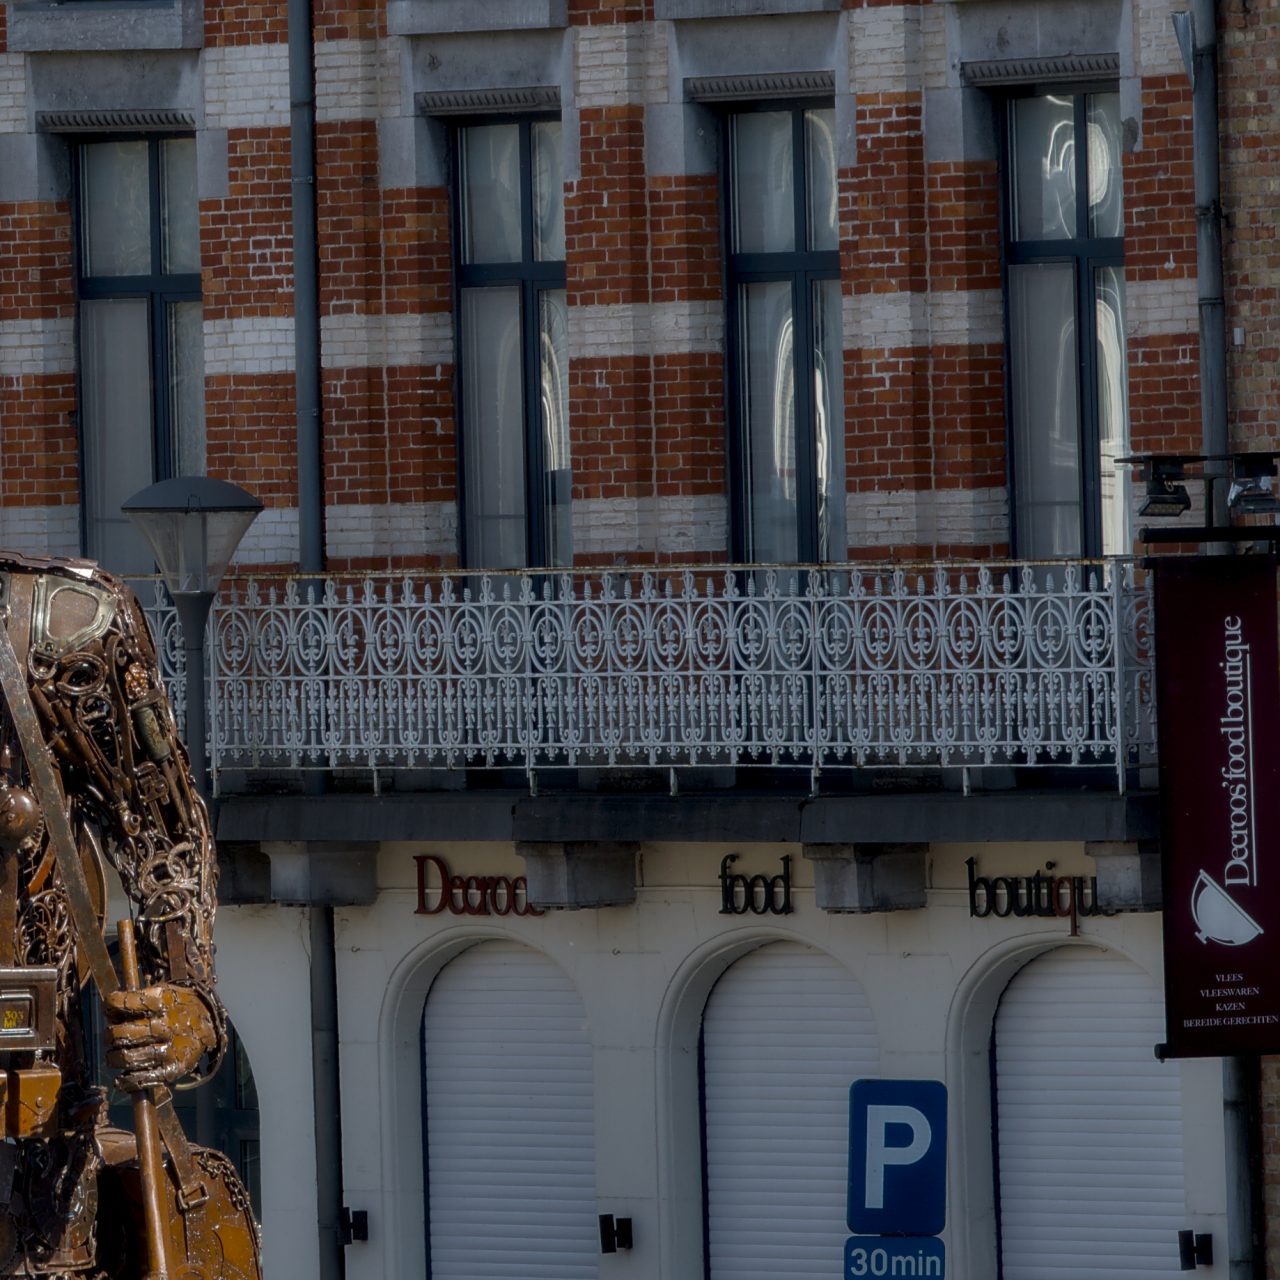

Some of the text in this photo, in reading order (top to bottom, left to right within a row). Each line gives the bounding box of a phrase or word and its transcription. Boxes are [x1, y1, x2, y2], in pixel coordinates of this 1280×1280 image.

[1219, 615, 1250, 723] boutique
[1220, 725, 1247, 780] food
[413, 854, 1116, 937] Decroo food boutiqu
[1200, 986, 1260, 997] VLEESWAREN
[1215, 973, 1244, 982] VLEES
[1183, 1015, 1279, 1028] BEREIDE GERECHTEN
[865, 1104, 932, 1209] P
